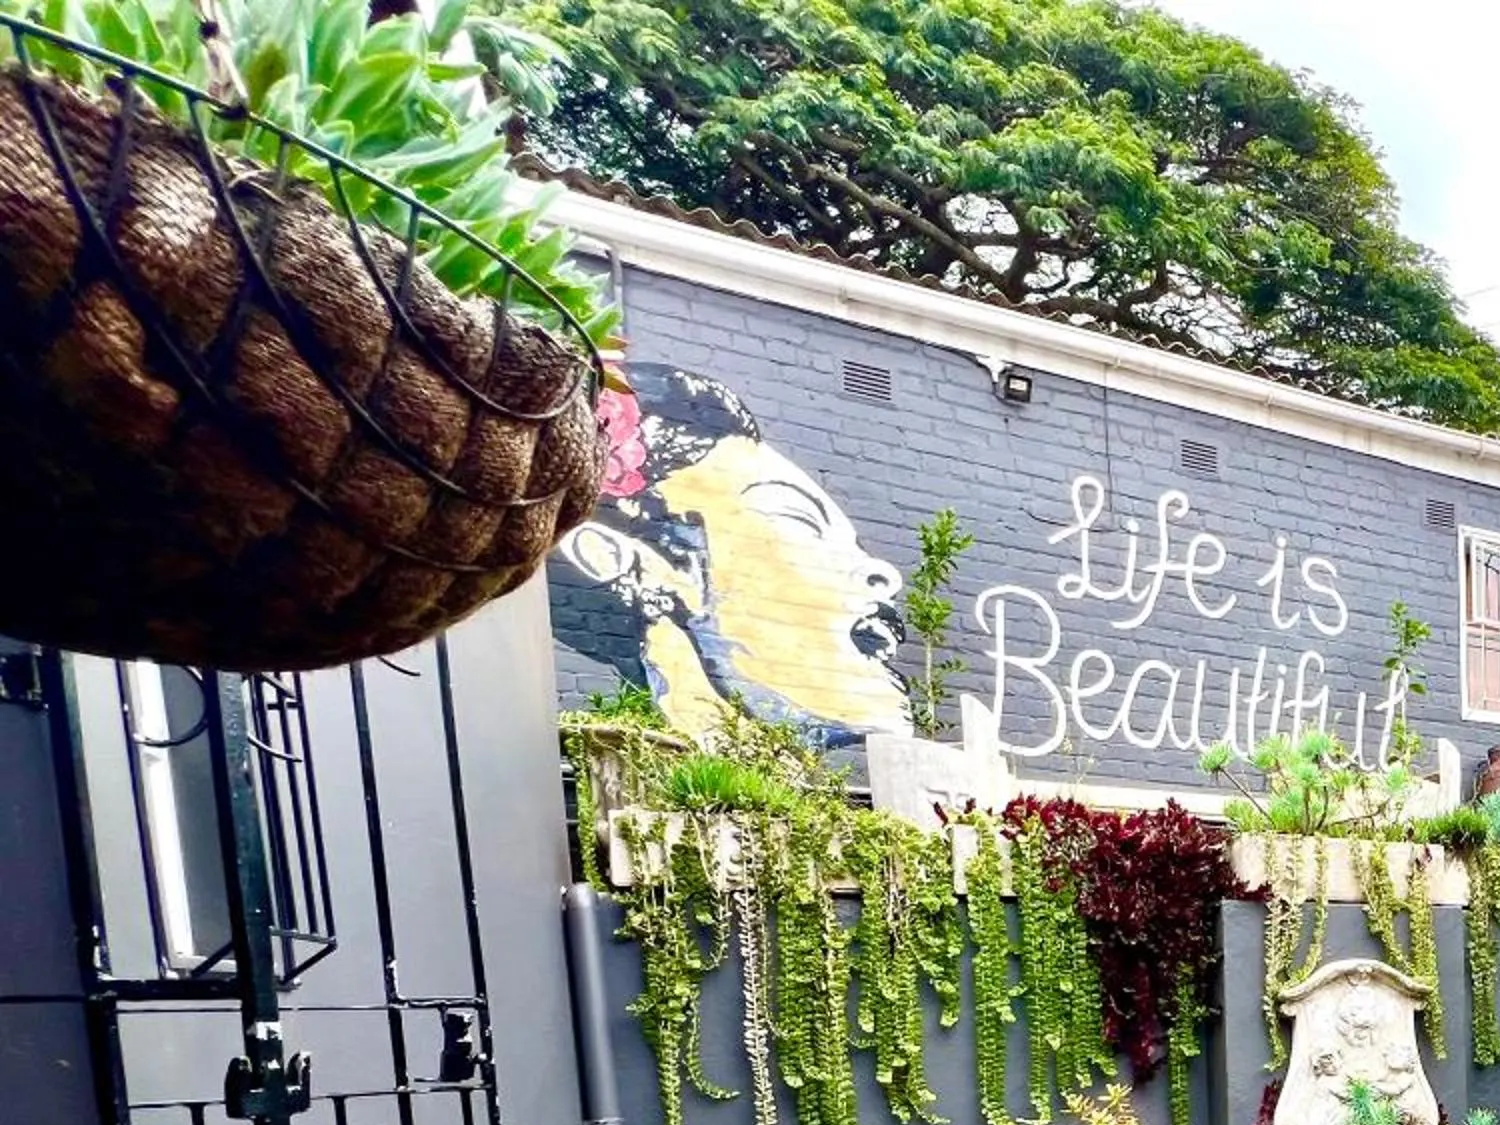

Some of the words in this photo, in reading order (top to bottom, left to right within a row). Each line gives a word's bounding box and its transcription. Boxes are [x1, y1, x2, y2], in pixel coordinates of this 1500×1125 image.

[1048, 475, 1237, 629] Life
[1257, 536, 1349, 636] is
[975, 584, 1409, 773] Beautiful
